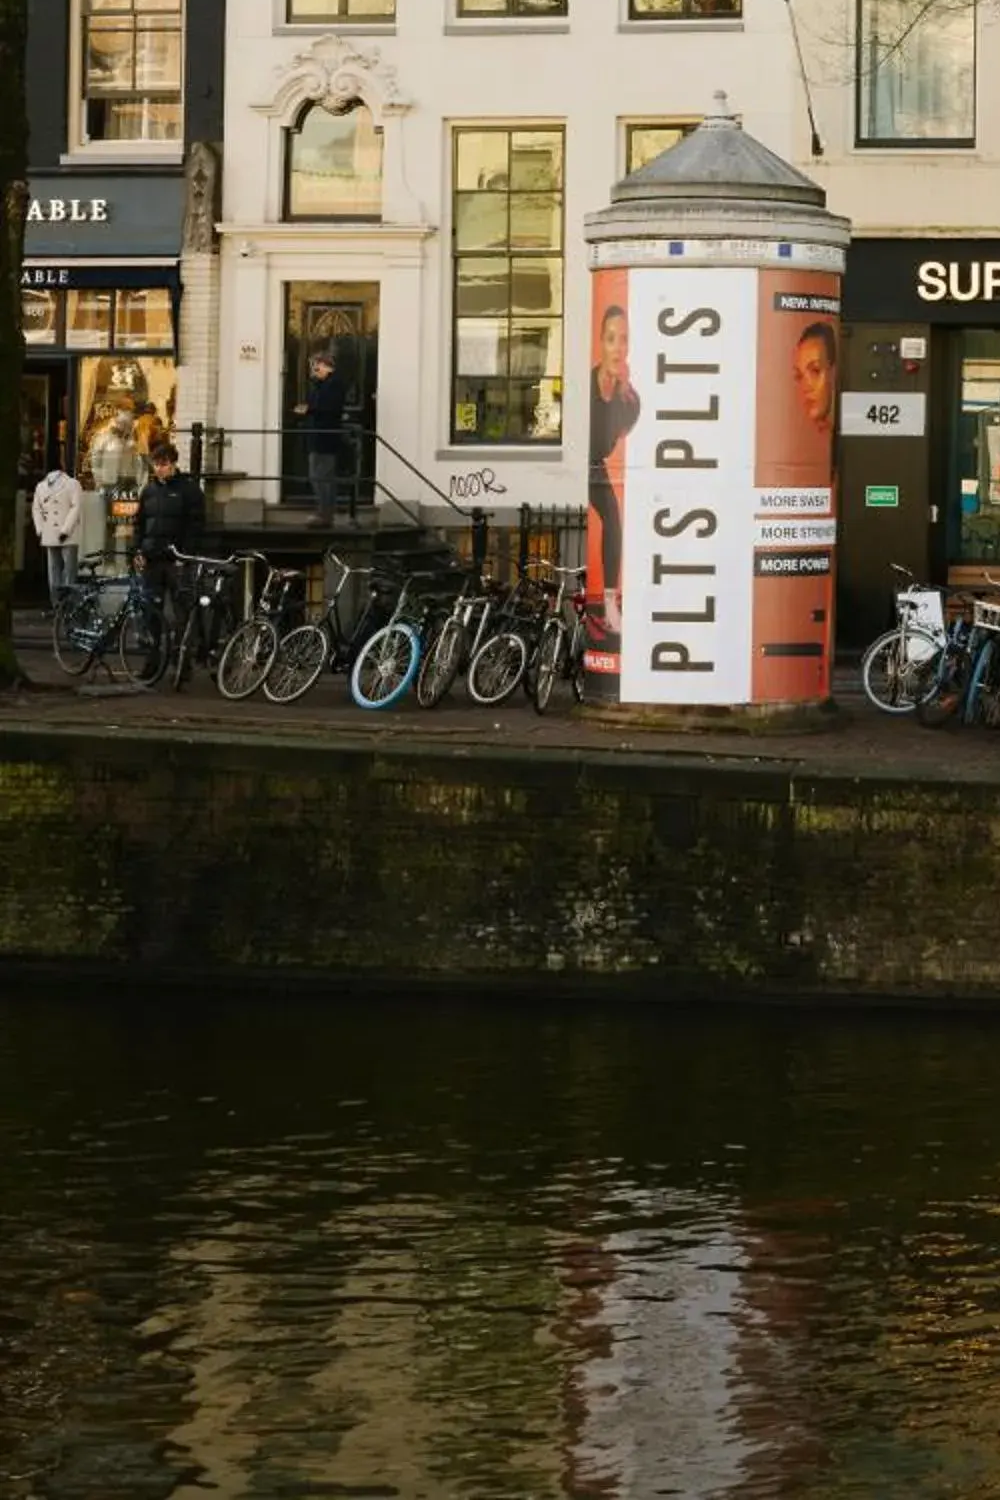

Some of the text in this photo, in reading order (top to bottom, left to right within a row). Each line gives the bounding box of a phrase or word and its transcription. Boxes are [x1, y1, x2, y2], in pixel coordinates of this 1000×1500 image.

[866, 404, 900, 424] 462
[651, 307, 721, 672] PLTS PLTS
[761, 495, 799, 507] MORE
[761, 527, 799, 539] MORE
[761, 558, 800, 571] MORE
